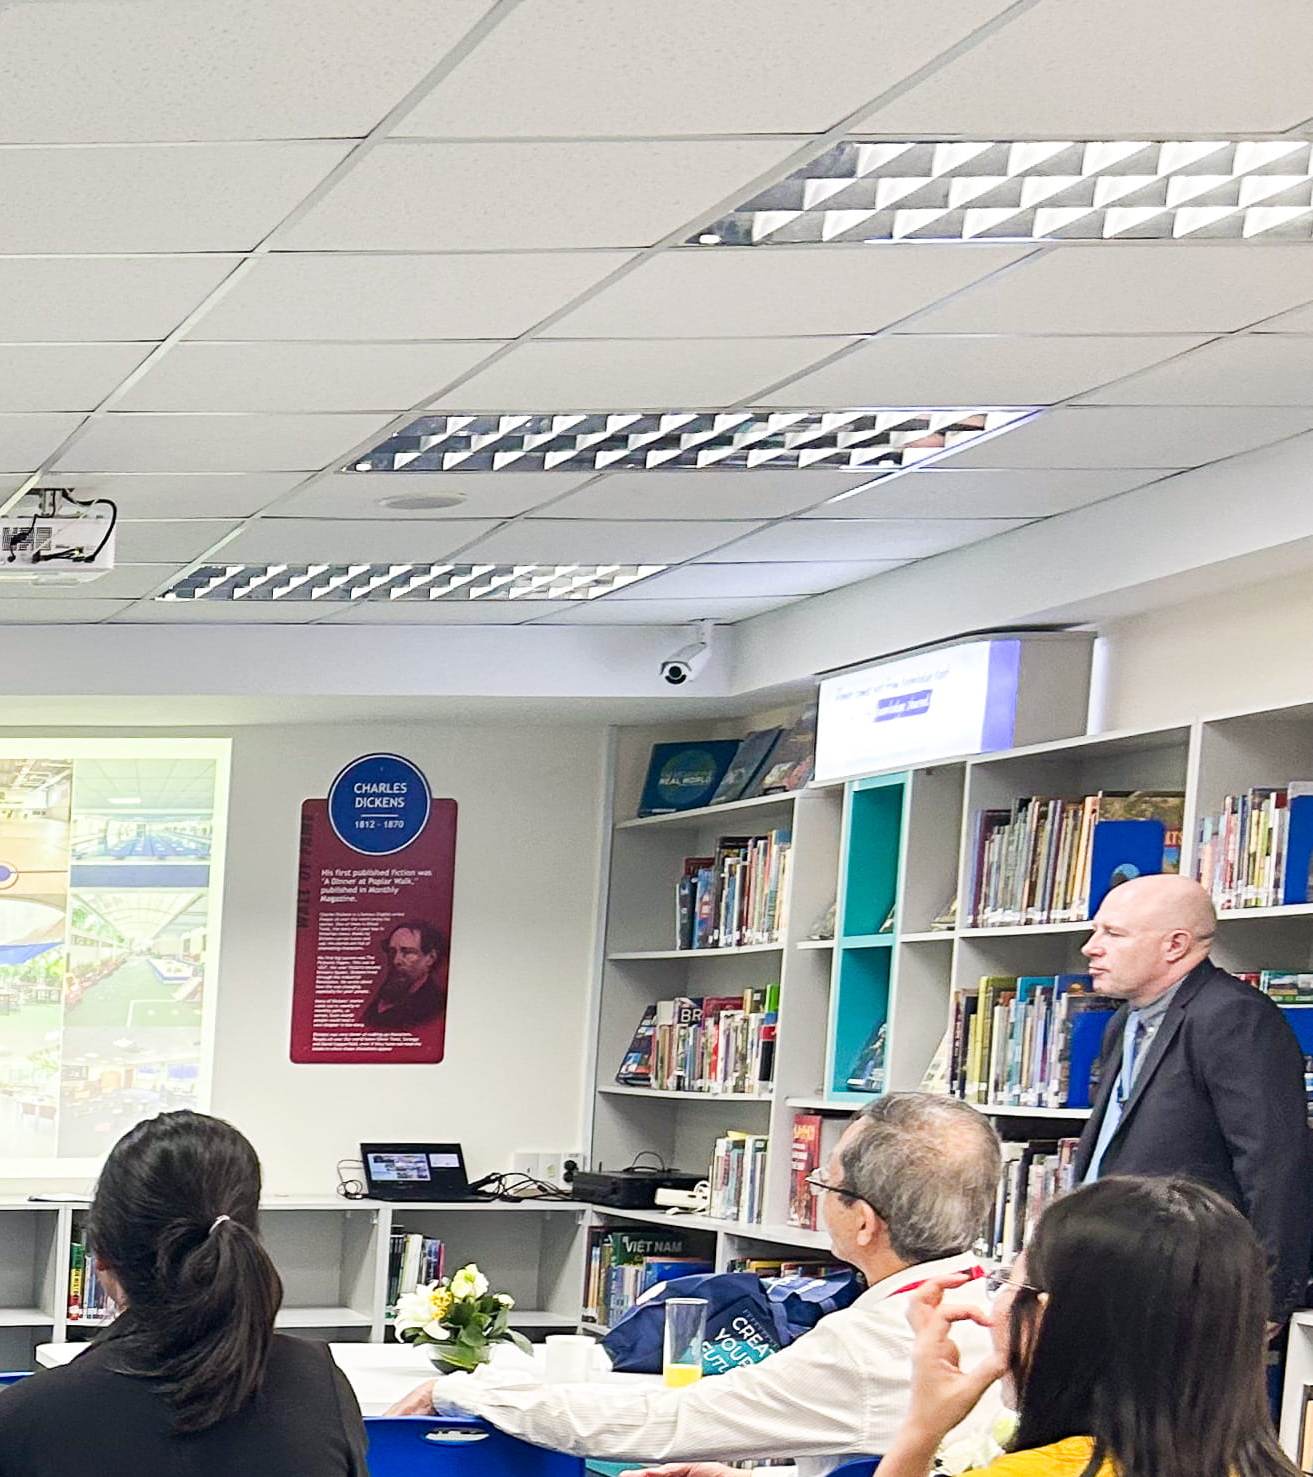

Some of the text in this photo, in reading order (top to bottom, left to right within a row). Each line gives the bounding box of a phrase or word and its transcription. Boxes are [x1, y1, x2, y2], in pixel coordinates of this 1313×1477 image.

[354, 782, 407, 794] CHARLES
[355, 797, 405, 809] DICKENS
[355, 820, 375, 829] 1812
[384, 820, 404, 829] 1870
[321, 869, 333, 877] His
[335, 869, 351, 877] first
[353, 869, 390, 878] published
[391, 869, 416, 877] fiction
[368, 878, 392, 886] Poplar
[320, 887, 358, 895] published
[368, 887, 399, 895] Monthly
[654, 1241, 682, 1253] NAM
